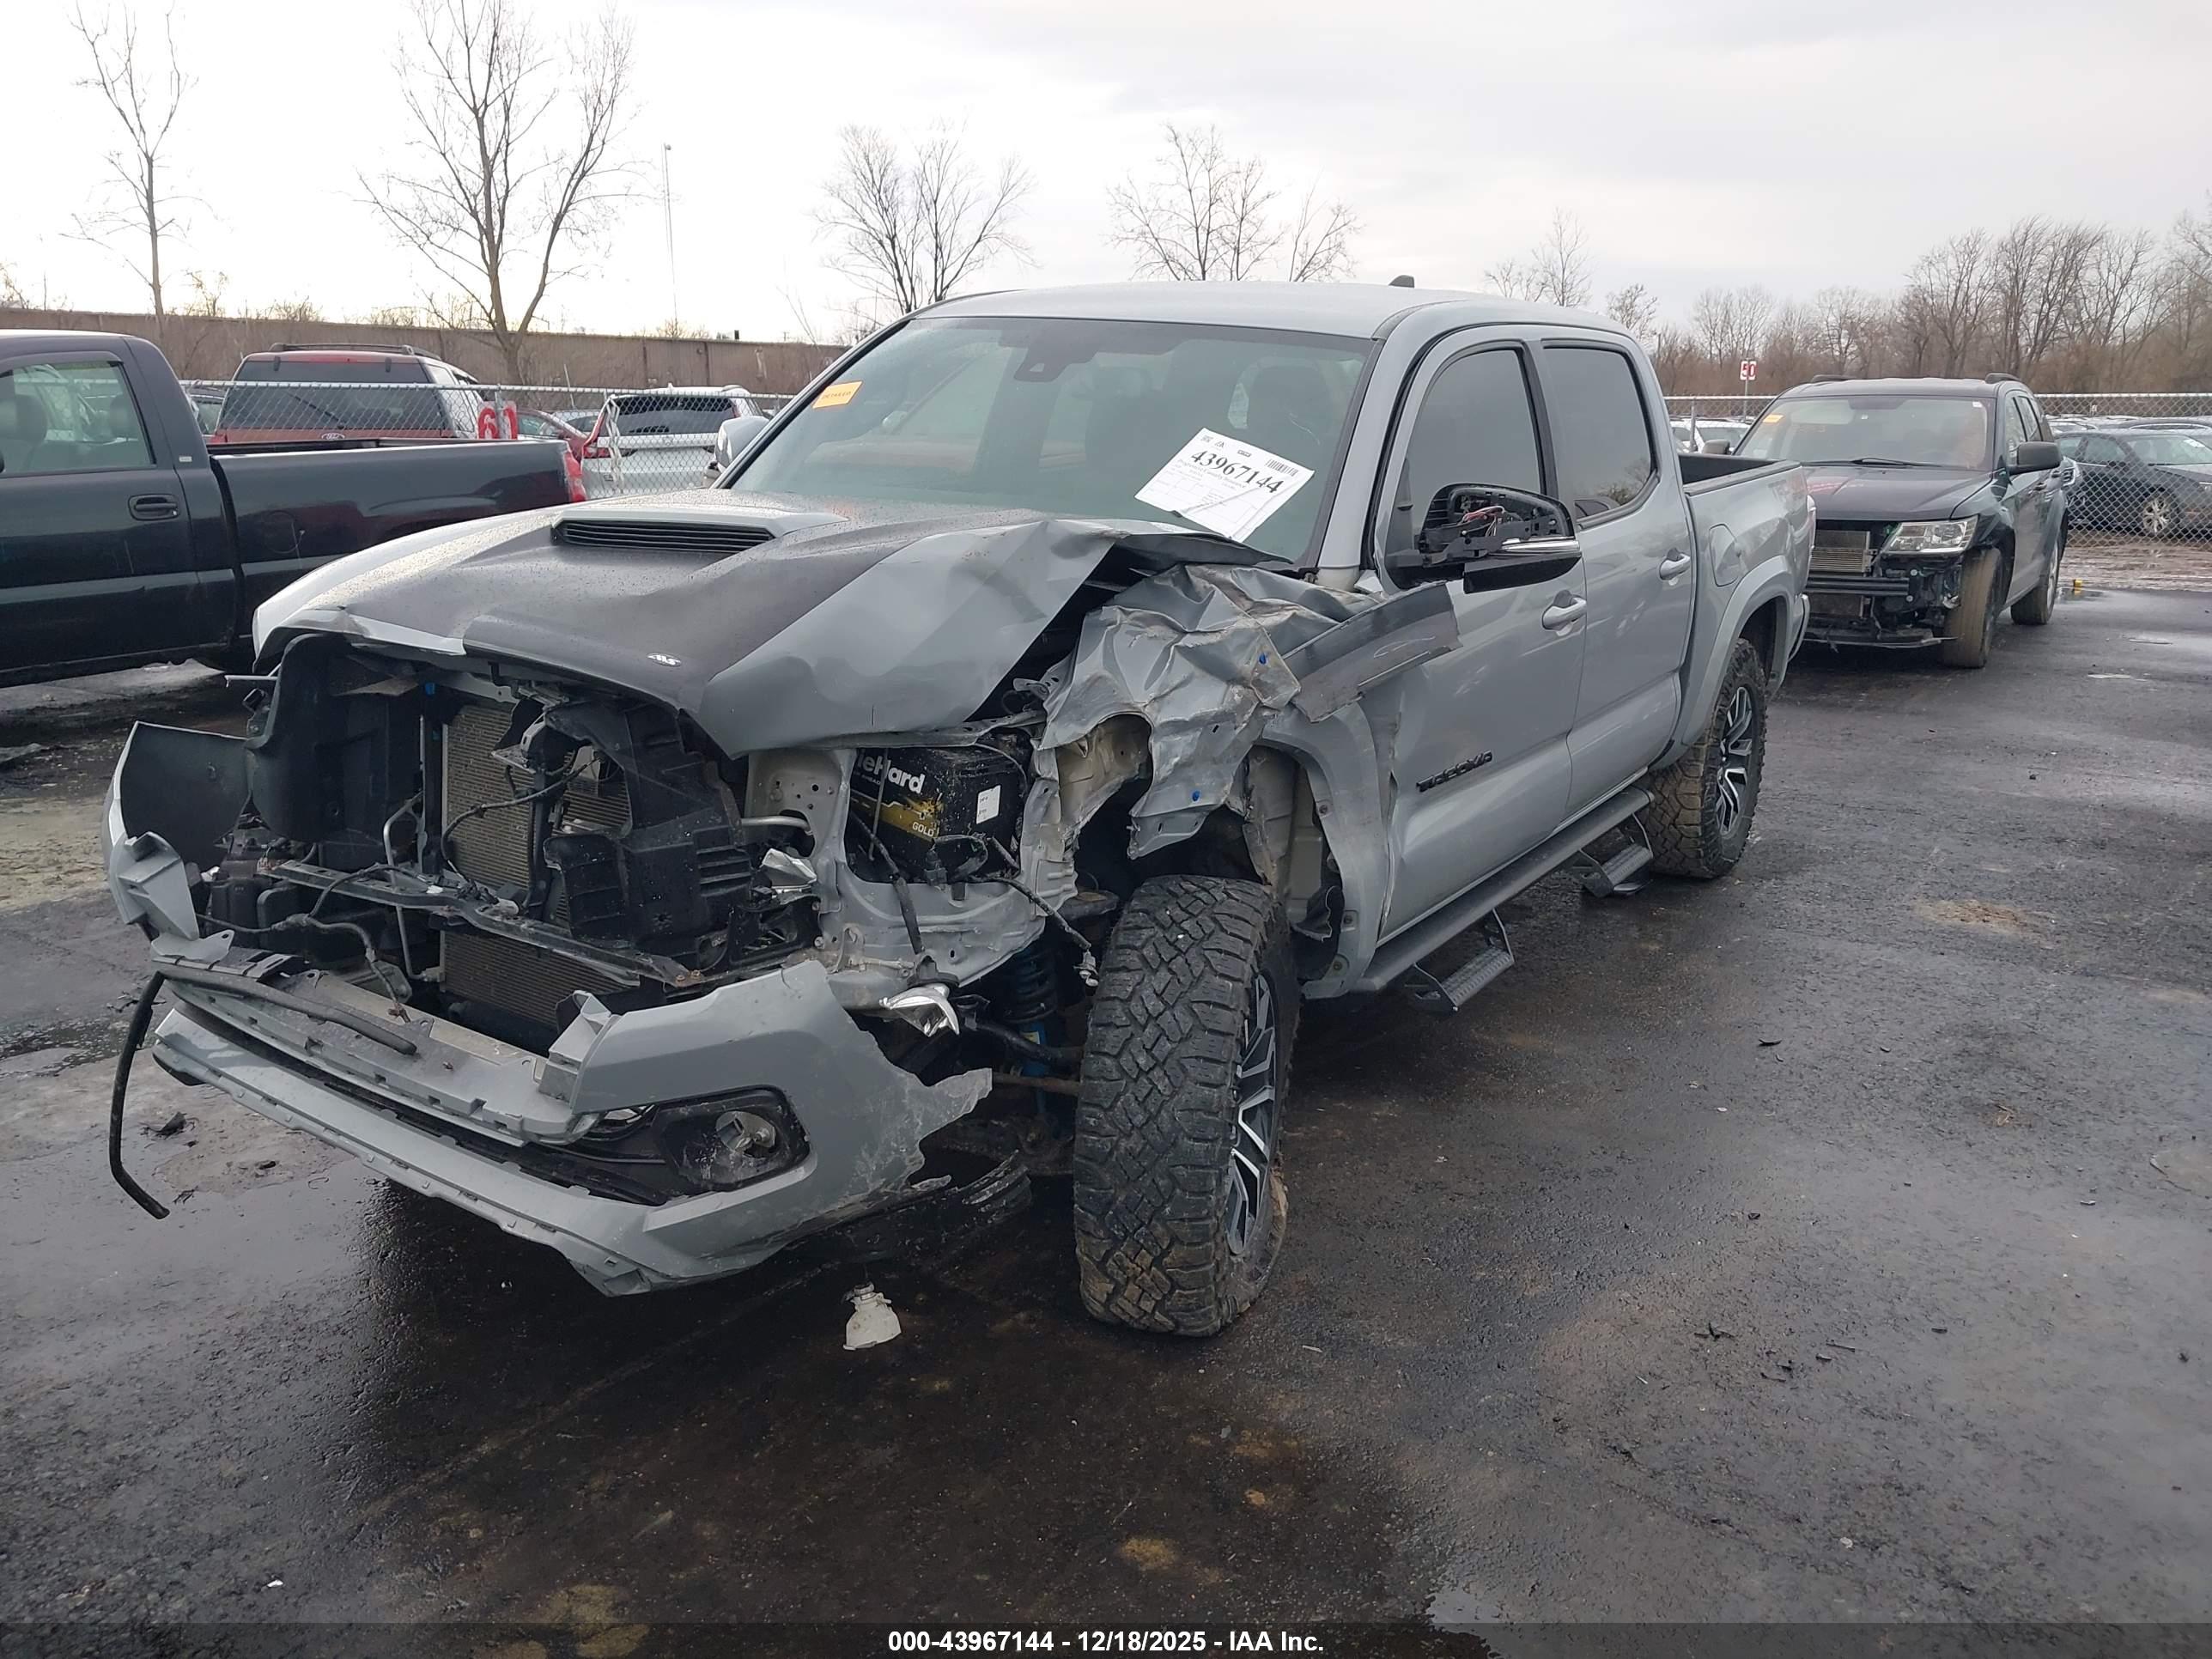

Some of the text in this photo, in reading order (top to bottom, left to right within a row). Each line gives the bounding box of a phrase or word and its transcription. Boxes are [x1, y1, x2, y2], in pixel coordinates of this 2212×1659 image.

[477, 407, 518, 440] 61
[1190, 449, 1285, 494] 43967144
[858, 752, 926, 793] ieHard
[1415, 750, 1492, 793] TACOMA
[911, 821, 934, 837] GOLD
